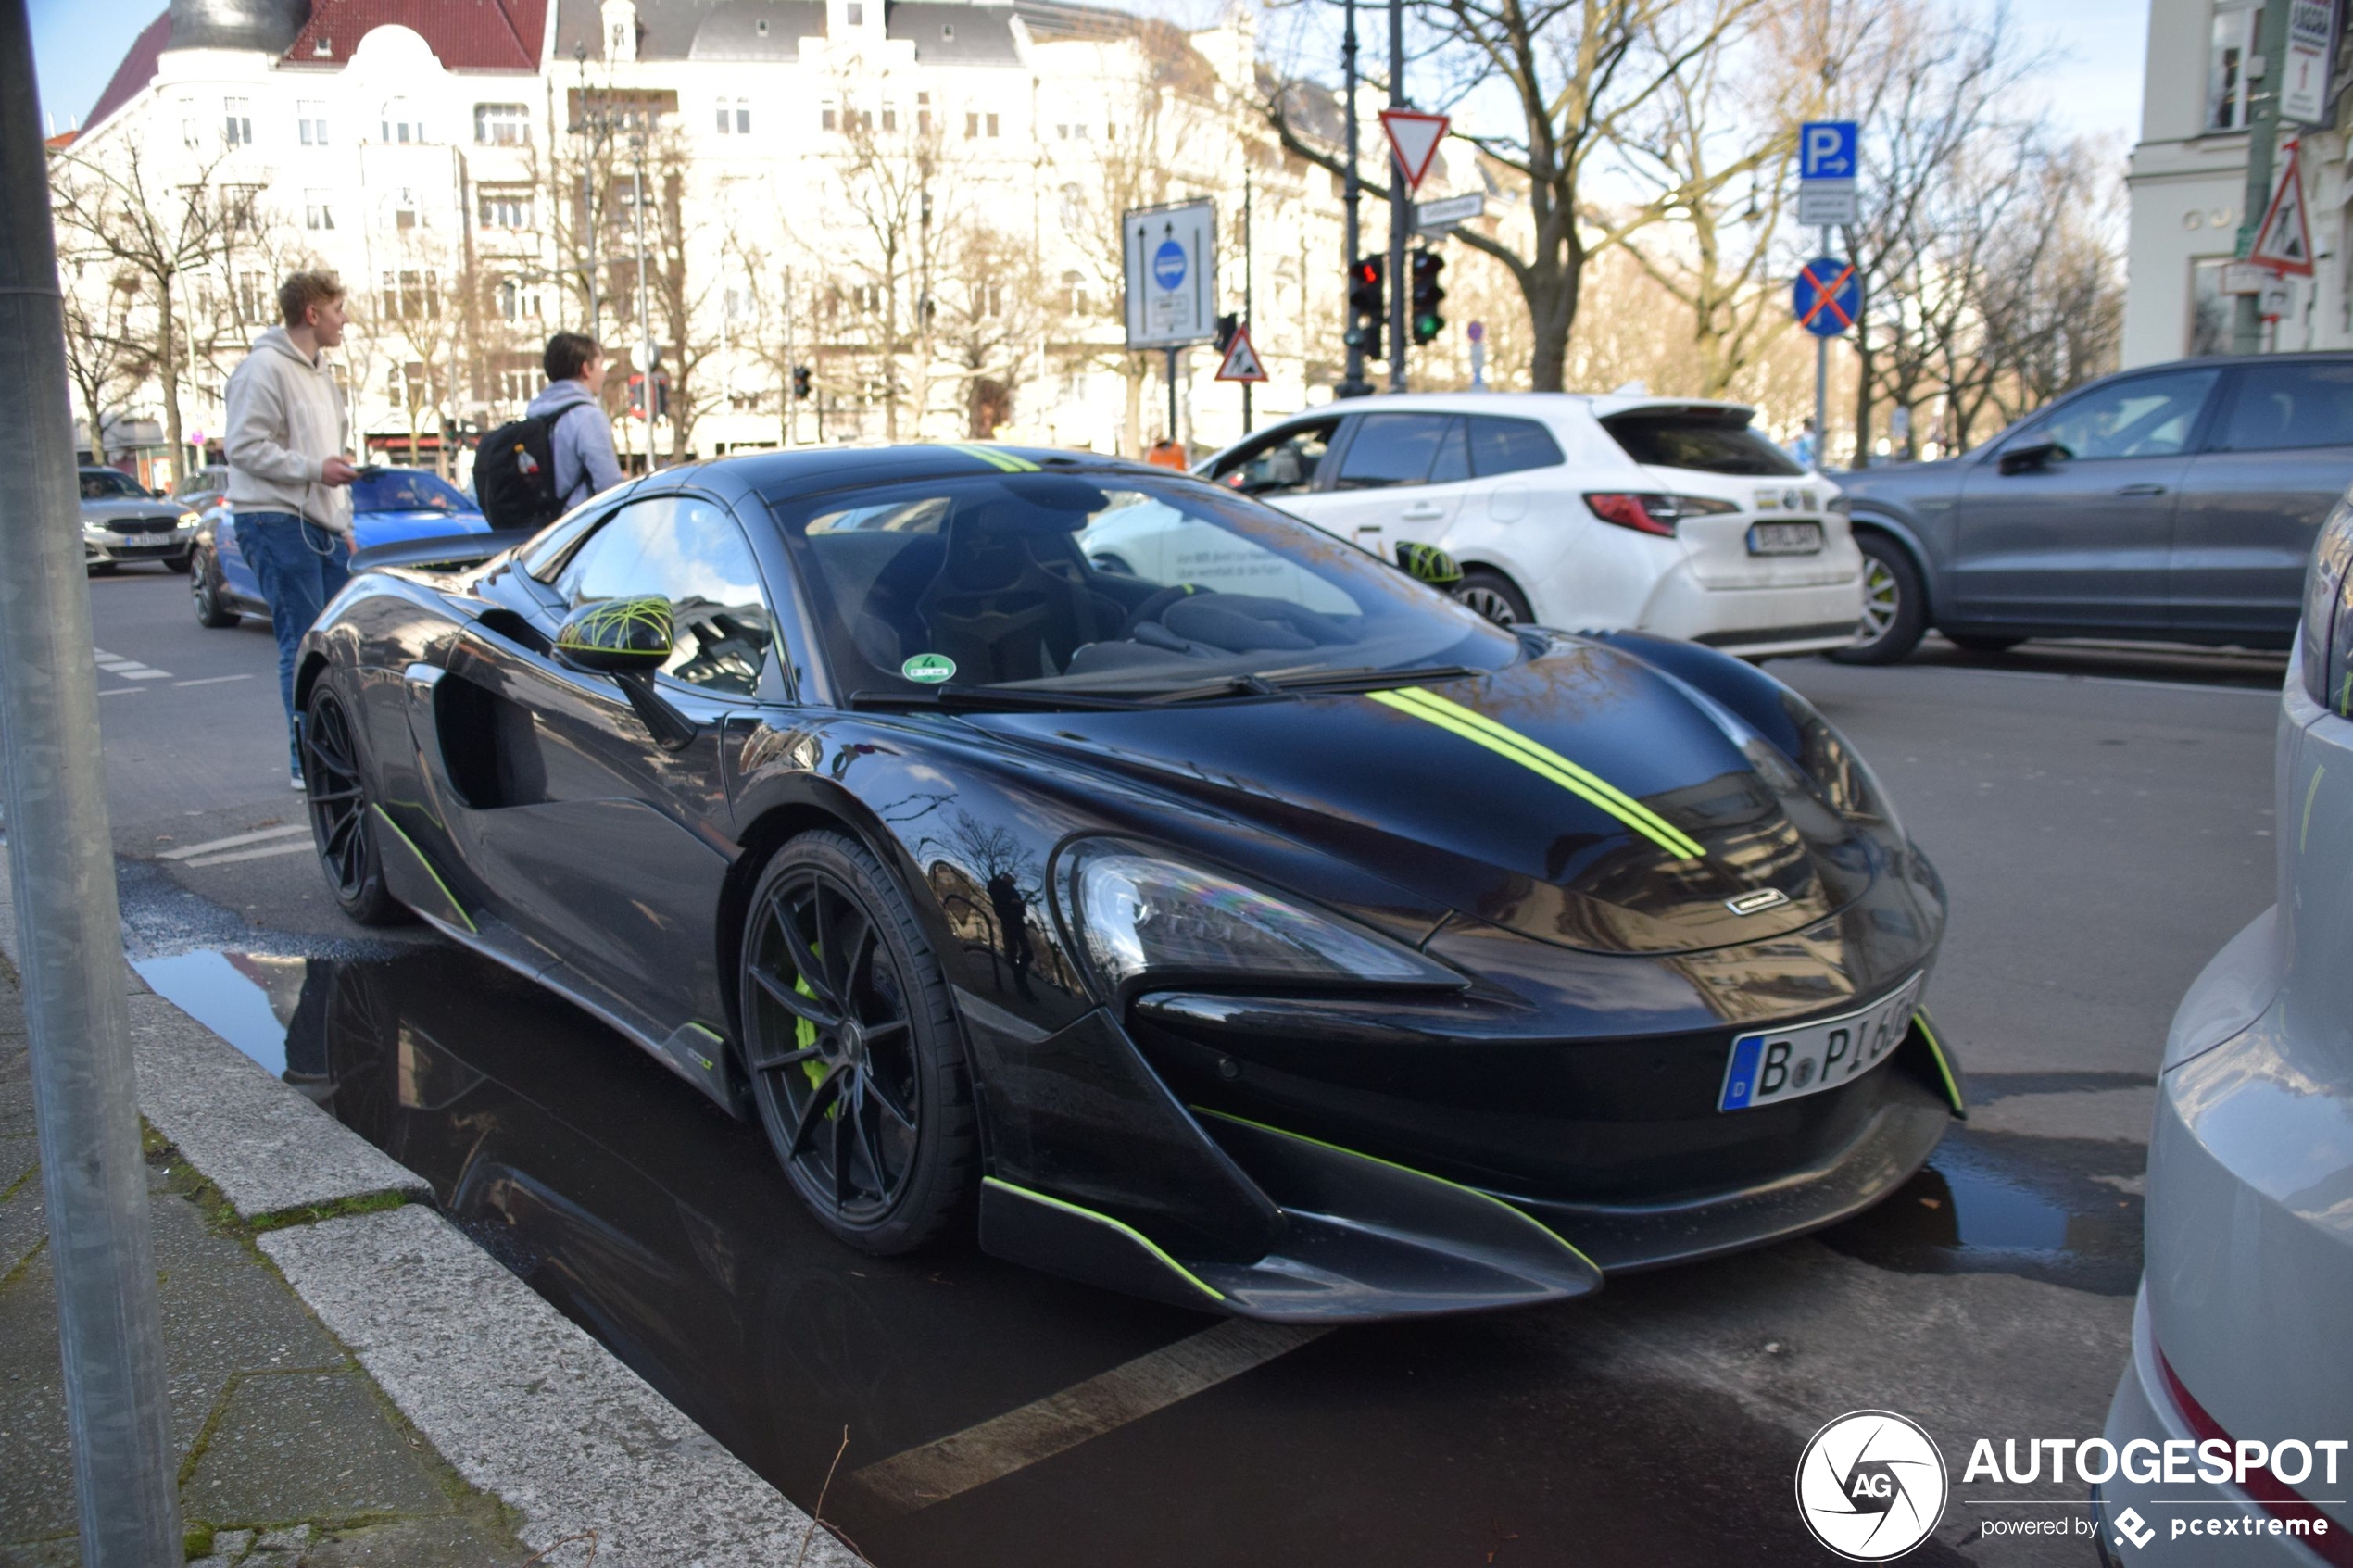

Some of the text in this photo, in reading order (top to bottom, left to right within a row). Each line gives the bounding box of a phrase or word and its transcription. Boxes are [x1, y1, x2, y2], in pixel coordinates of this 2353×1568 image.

[1807, 128, 1843, 174] P
[1758, 1040, 1793, 1097] B
[1820, 1020, 1869, 1083] PI
